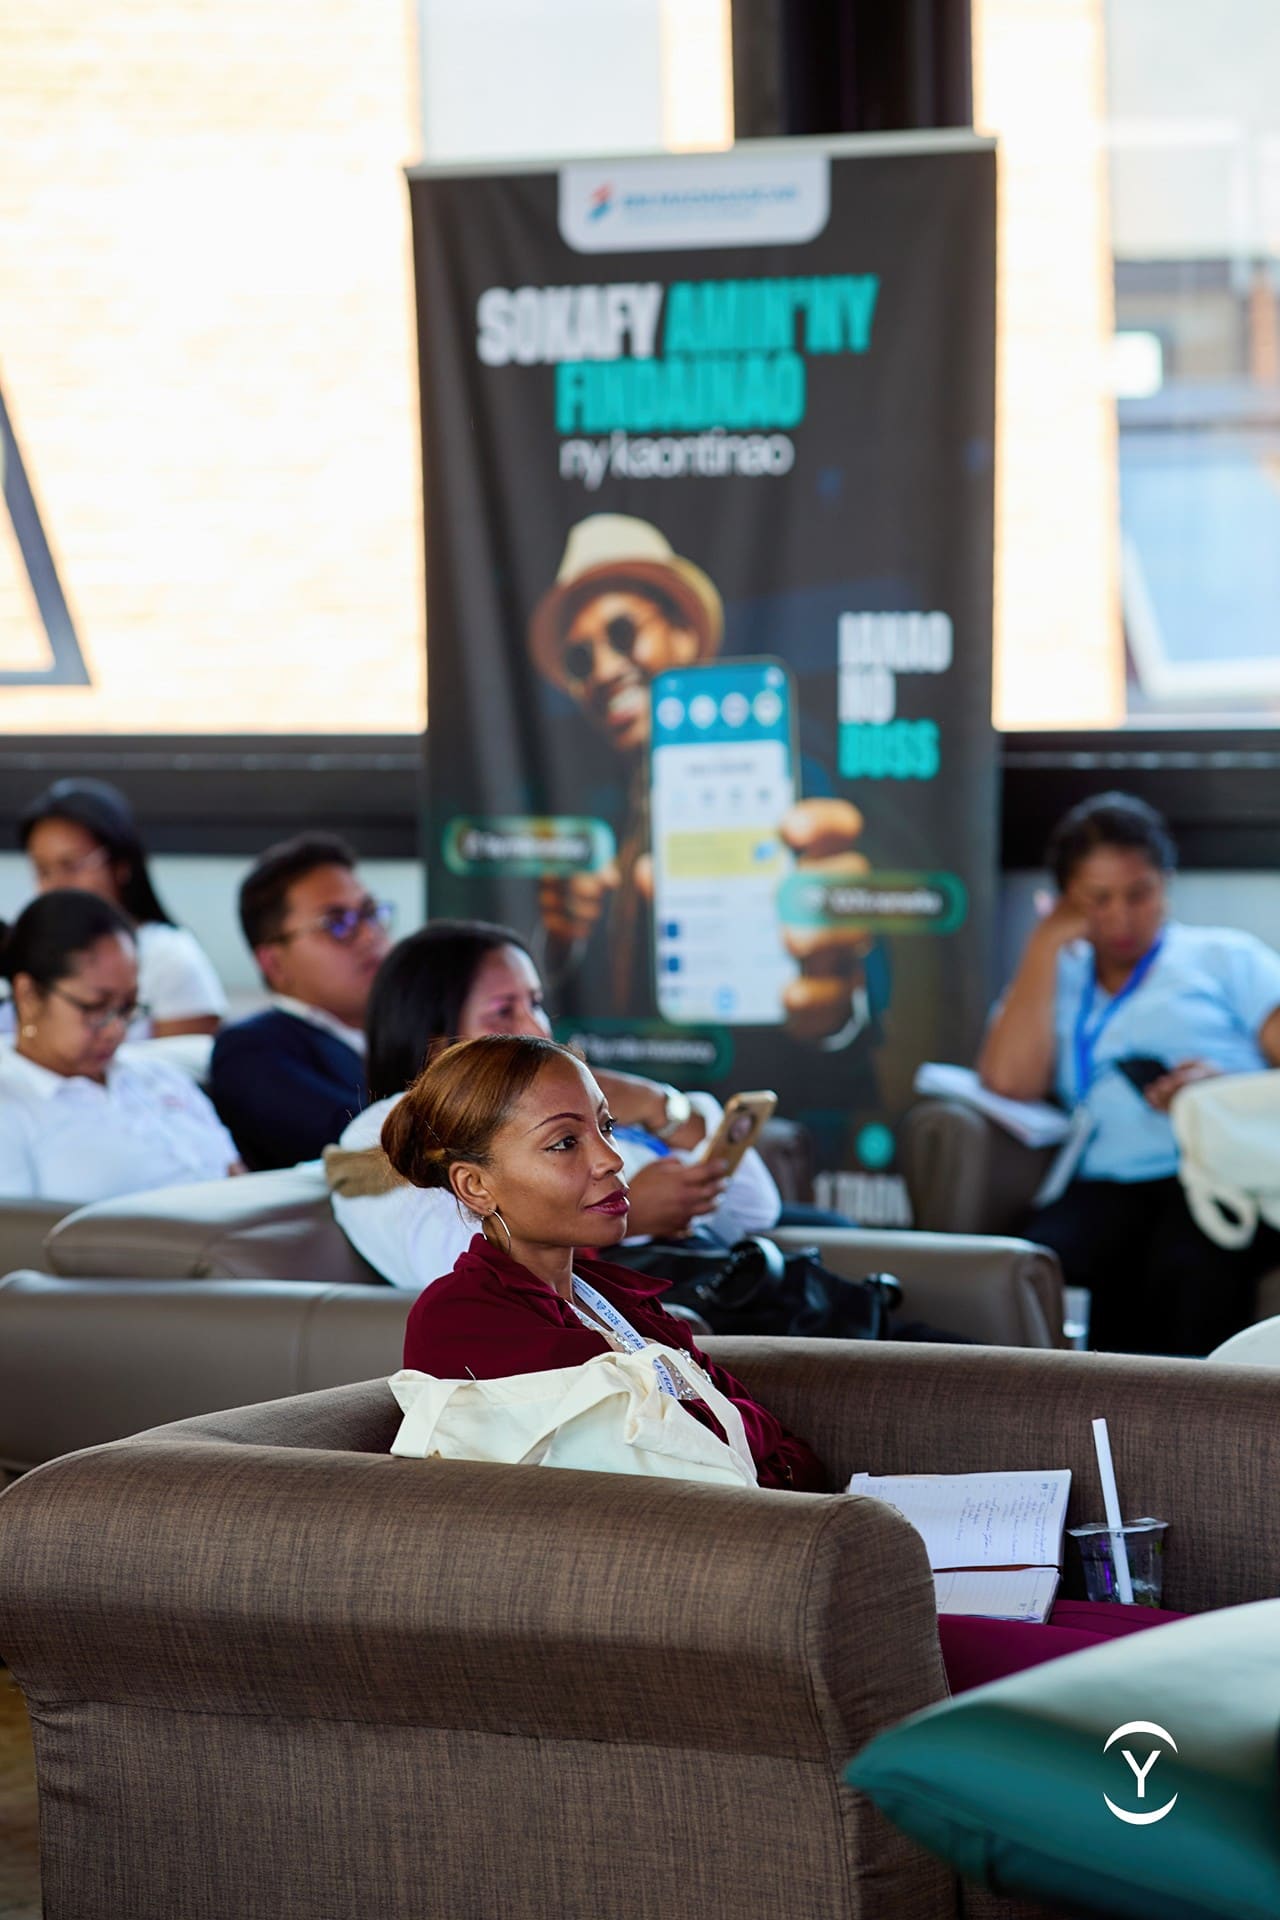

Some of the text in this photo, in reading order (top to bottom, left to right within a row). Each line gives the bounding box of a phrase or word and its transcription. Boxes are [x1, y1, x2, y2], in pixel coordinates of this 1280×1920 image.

[477, 283, 662, 364] SOKAFY
[560, 429, 794, 490] ny kaontinao
